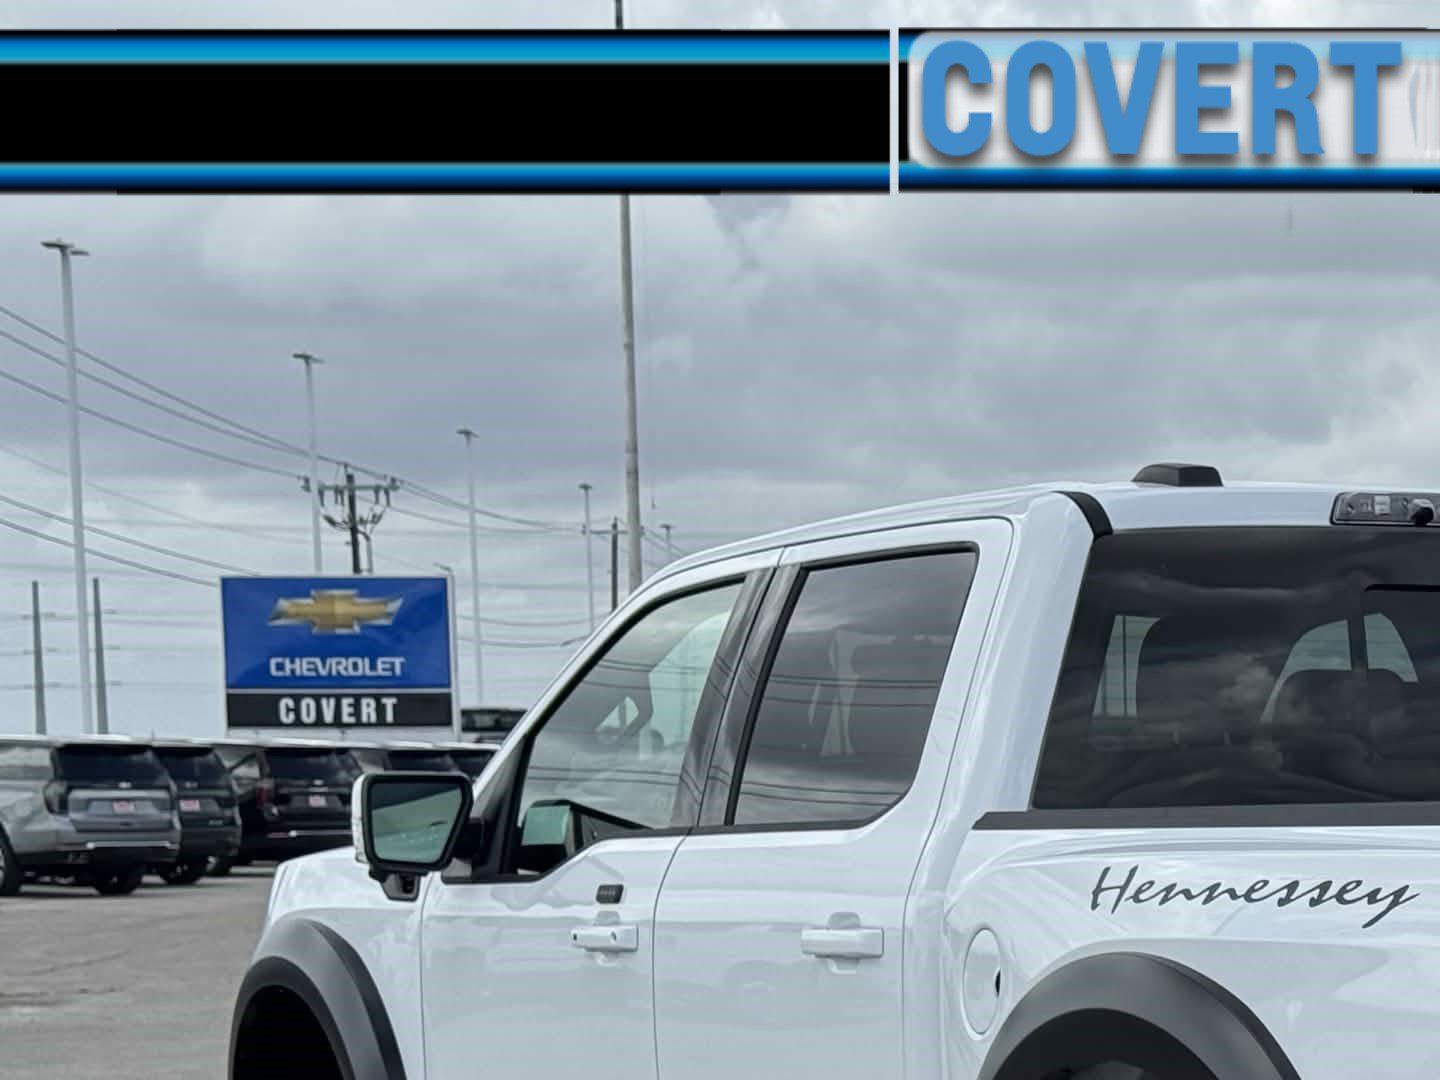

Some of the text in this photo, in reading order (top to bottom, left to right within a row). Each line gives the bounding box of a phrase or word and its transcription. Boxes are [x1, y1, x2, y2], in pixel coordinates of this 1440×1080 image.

[269, 656, 407, 677] CHEVROLET
[278, 697, 398, 724] COVERT
[1090, 864, 1421, 929] Hennessey
